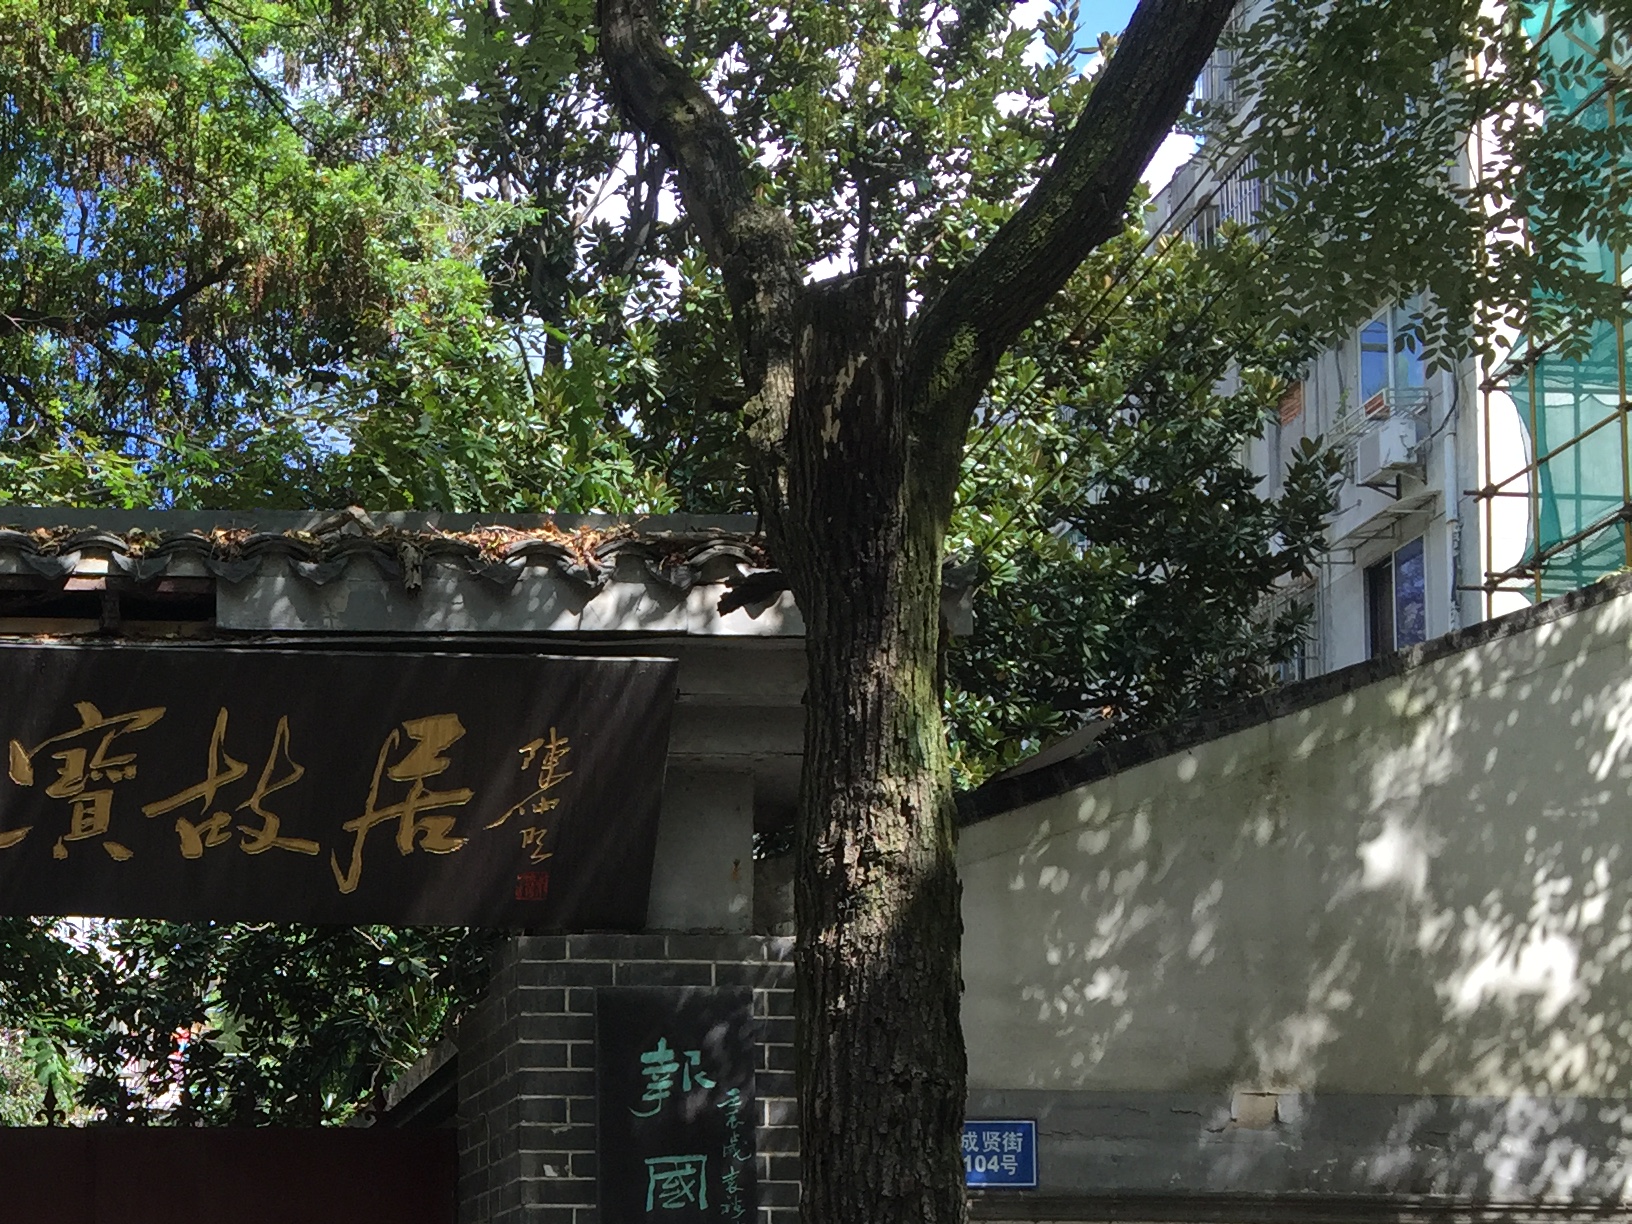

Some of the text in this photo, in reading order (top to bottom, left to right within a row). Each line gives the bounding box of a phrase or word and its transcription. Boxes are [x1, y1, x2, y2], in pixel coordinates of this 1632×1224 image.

[961, 1130, 1024, 1153] 成贤街
[963, 1154, 1019, 1176] 104号
